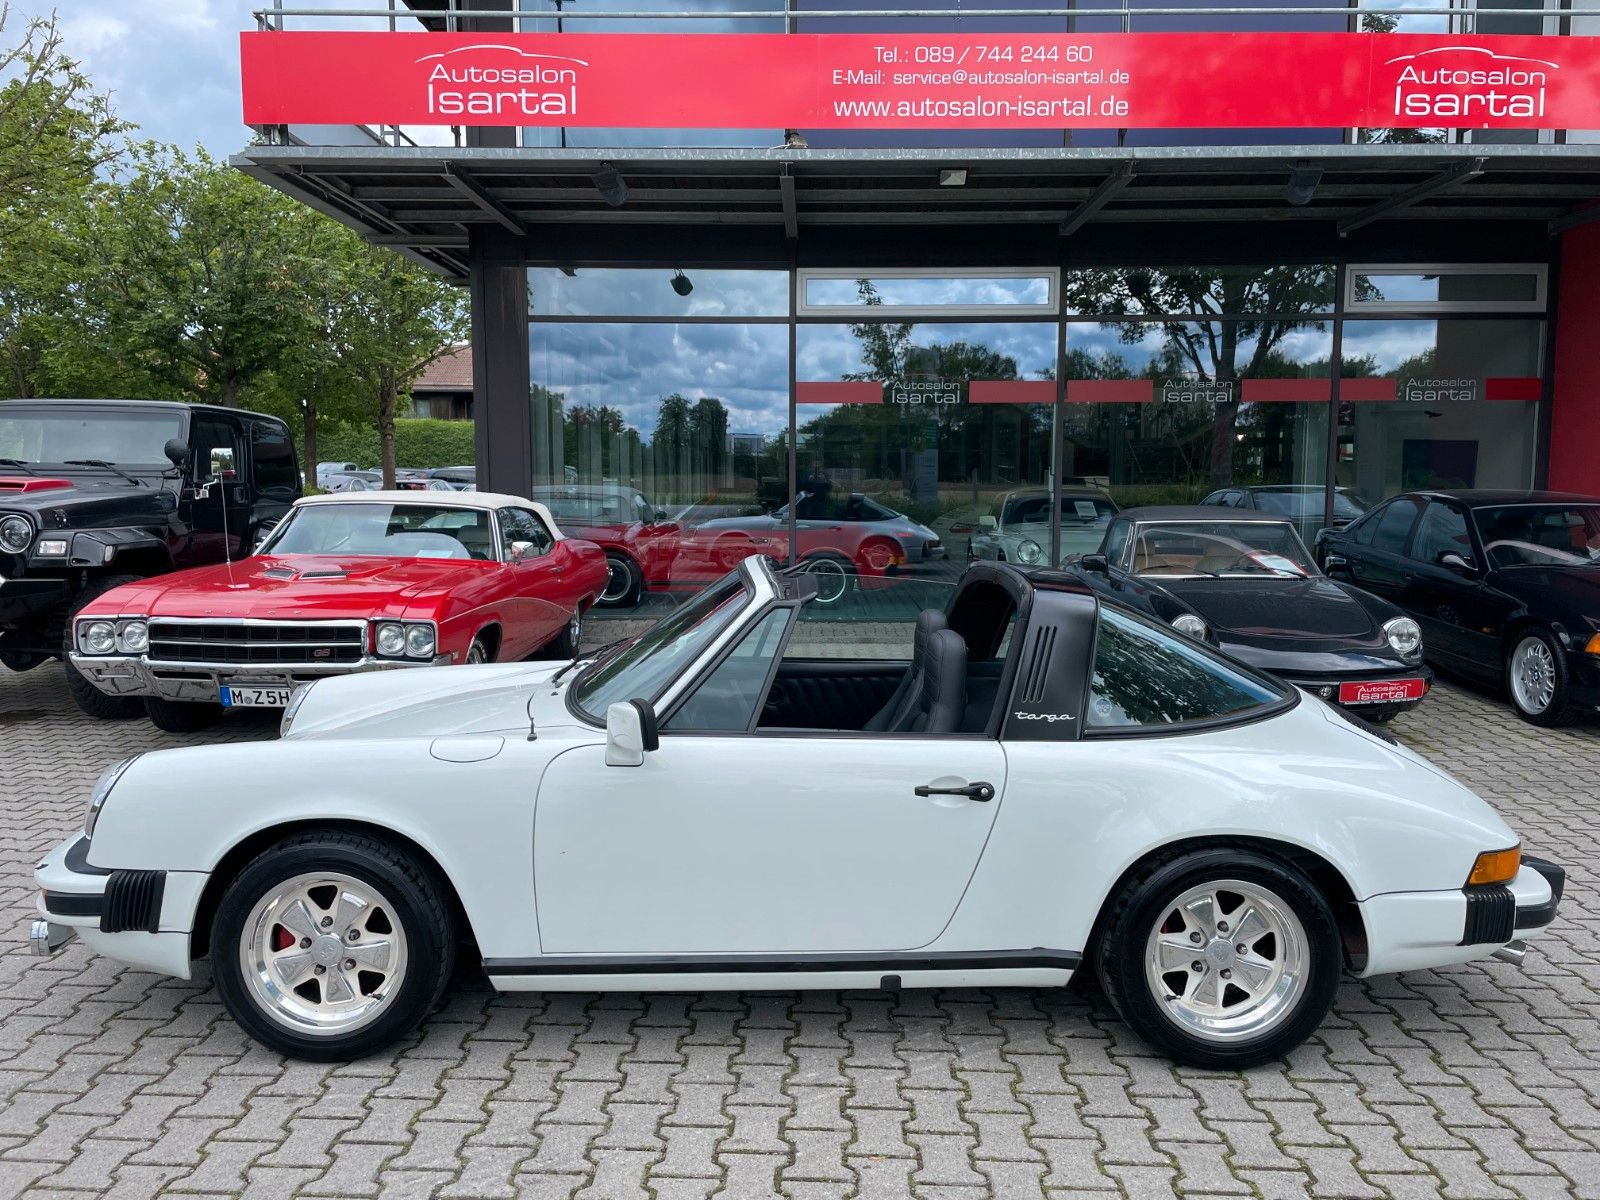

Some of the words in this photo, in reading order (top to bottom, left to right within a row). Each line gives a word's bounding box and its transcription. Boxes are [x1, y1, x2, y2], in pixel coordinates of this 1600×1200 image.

[873, 46, 909, 63] Tel.:
[914, 46, 955, 63] 089
[975, 45, 1013, 63] 744
[1020, 45, 1060, 63] 244
[1066, 45, 1093, 63] 60
[428, 63, 576, 84] Autosalon
[832, 69, 886, 85] E-Mail:
[893, 68, 1130, 85] service@autosalon-isartal.de
[1397, 65, 1546, 86] Autosalon
[428, 84, 577, 115] Isartal
[833, 94, 1129, 117] www.autosalon-isartal.de
[1394, 85, 1546, 117] Isartal
[892, 379, 960, 390] Autosalon
[1163, 379, 1233, 389] Autosalon
[1406, 377, 1477, 387] Autosalon
[891, 389, 961, 404] Isartal
[1162, 388, 1233, 403] Isartal
[1405, 386, 1476, 401] Isartal
[1357, 688, 1408, 701] Isartal
[1359, 685, 1408, 693] Autosalon
[231, 689, 244, 705] M
[1014, 711, 1076, 723] targa
